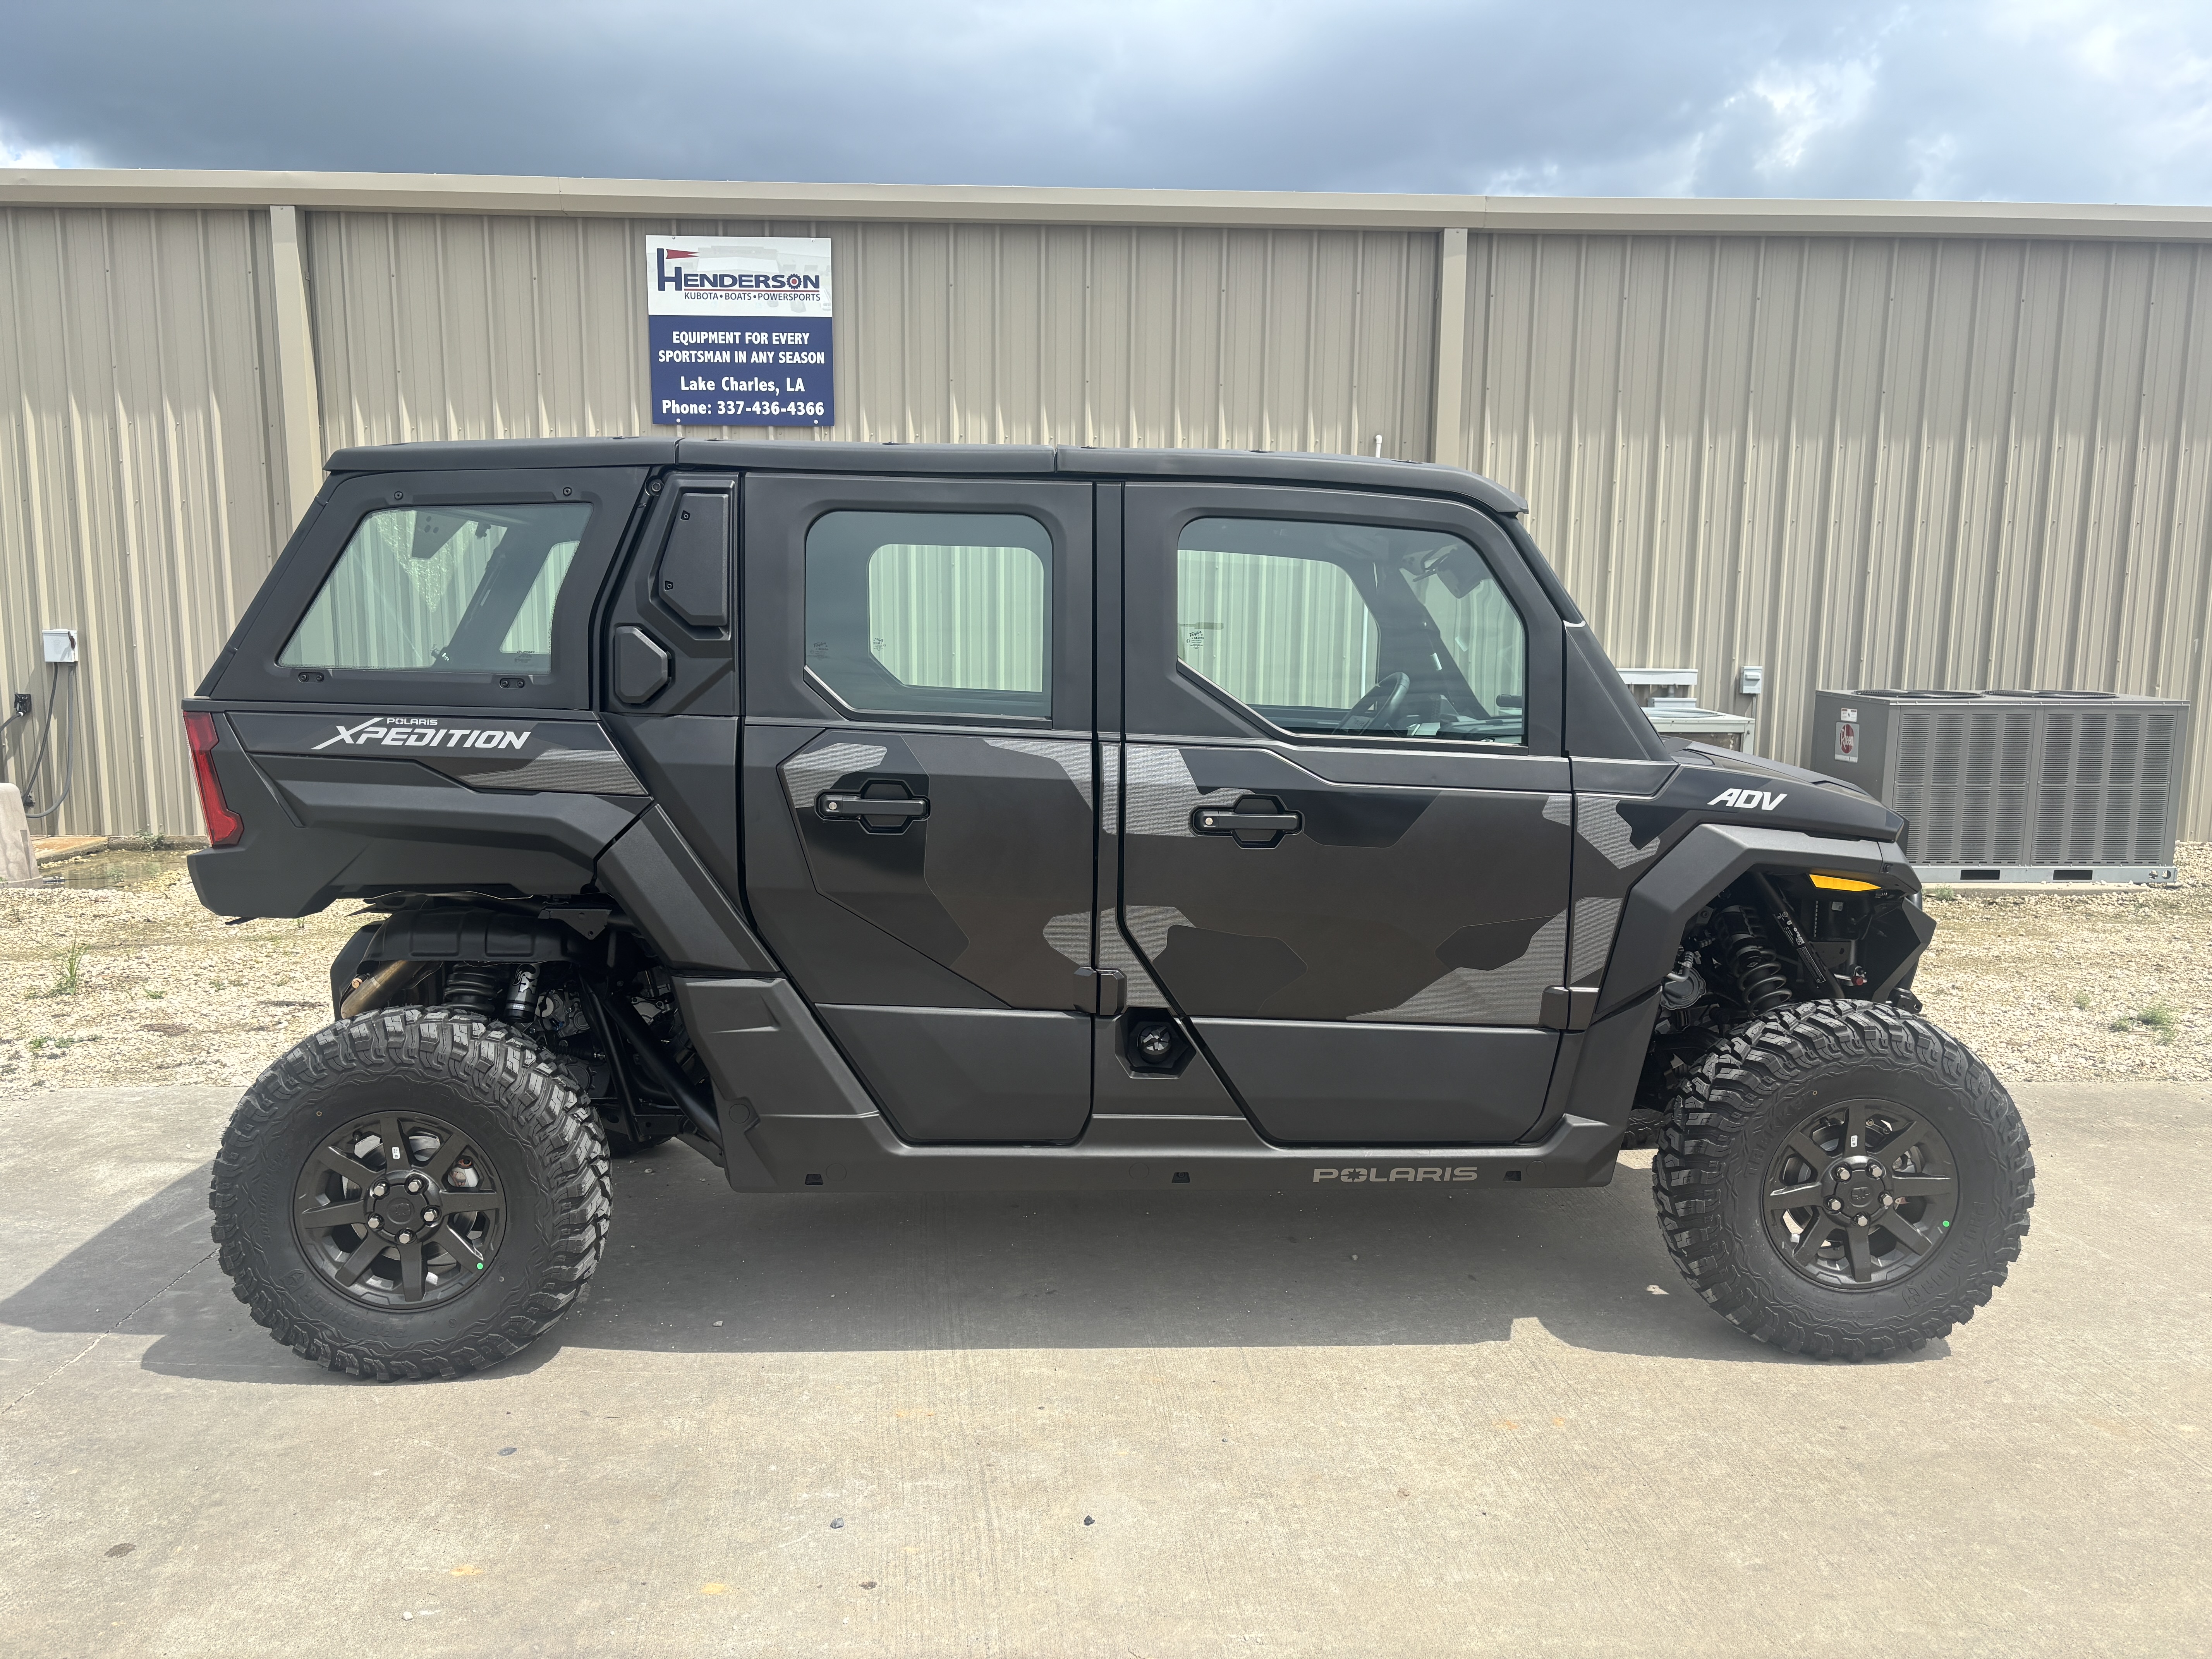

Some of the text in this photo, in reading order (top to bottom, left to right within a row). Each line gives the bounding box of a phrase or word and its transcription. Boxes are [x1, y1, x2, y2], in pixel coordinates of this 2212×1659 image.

[657, 248, 820, 291] HENDERSON
[673, 331, 809, 345] EQUIPMENT FOR EVERY
[658, 350, 825, 364] SPORTSMAN IN ANY SEASON
[680, 376, 805, 396] Lake Charles, LA
[662, 400, 824, 416] Phone: 337-436-4366
[311, 718, 531, 749] XPEDITION
[1707, 788, 1788, 811] ADV
[1313, 1167, 1478, 1183] POLARIS
